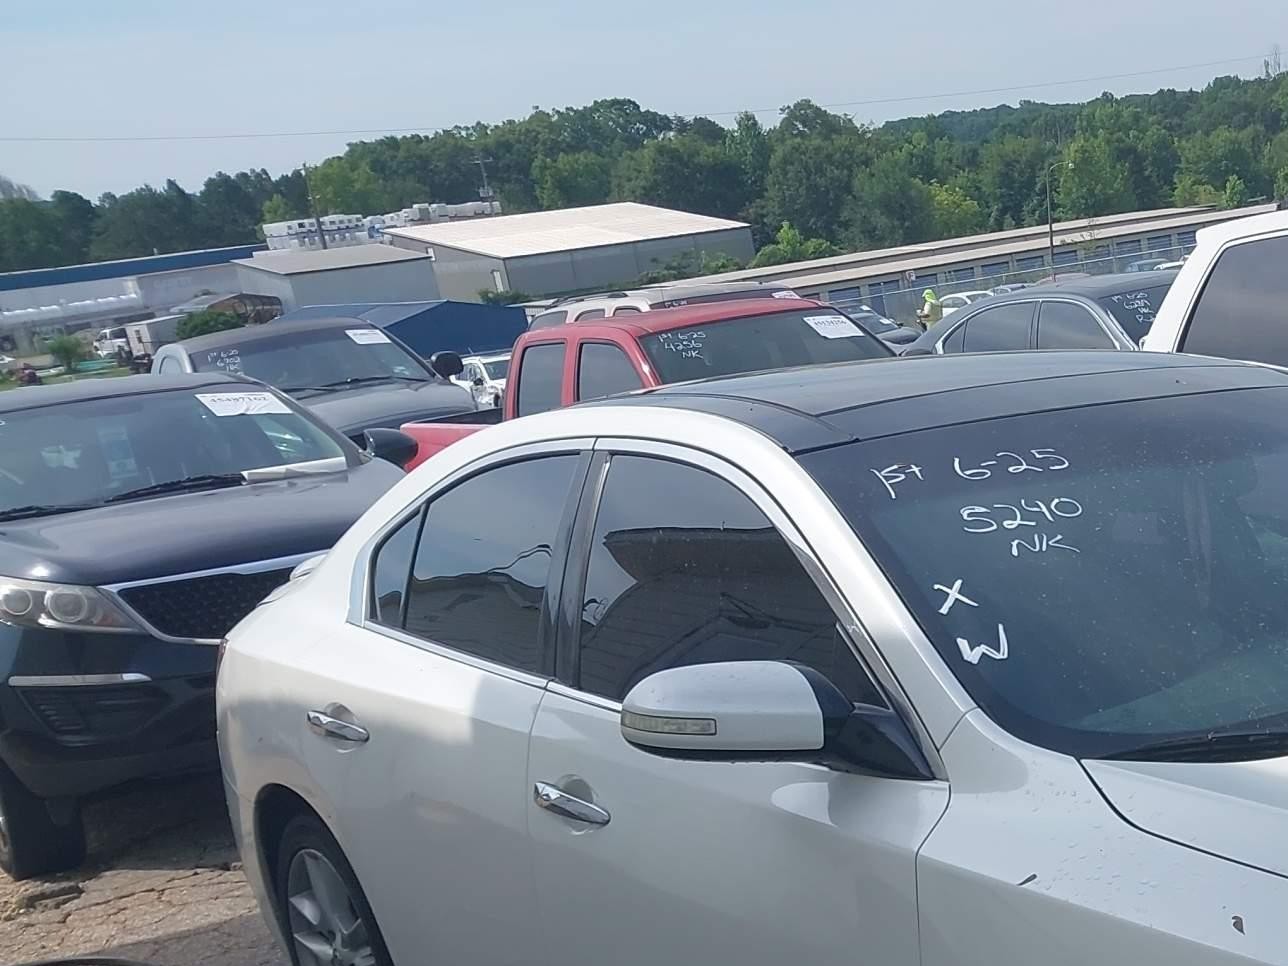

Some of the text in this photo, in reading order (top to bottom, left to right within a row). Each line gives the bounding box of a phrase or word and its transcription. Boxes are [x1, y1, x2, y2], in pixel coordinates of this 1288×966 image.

[664, 340, 703, 351] 4256
[682, 350, 704, 359] NK
[953, 448, 1069, 480] 6-25
[959, 497, 1083, 533] 5240
[1010, 533, 1081, 557] NK
[932, 578, 979, 615] X
[955, 623, 1008, 665] W
